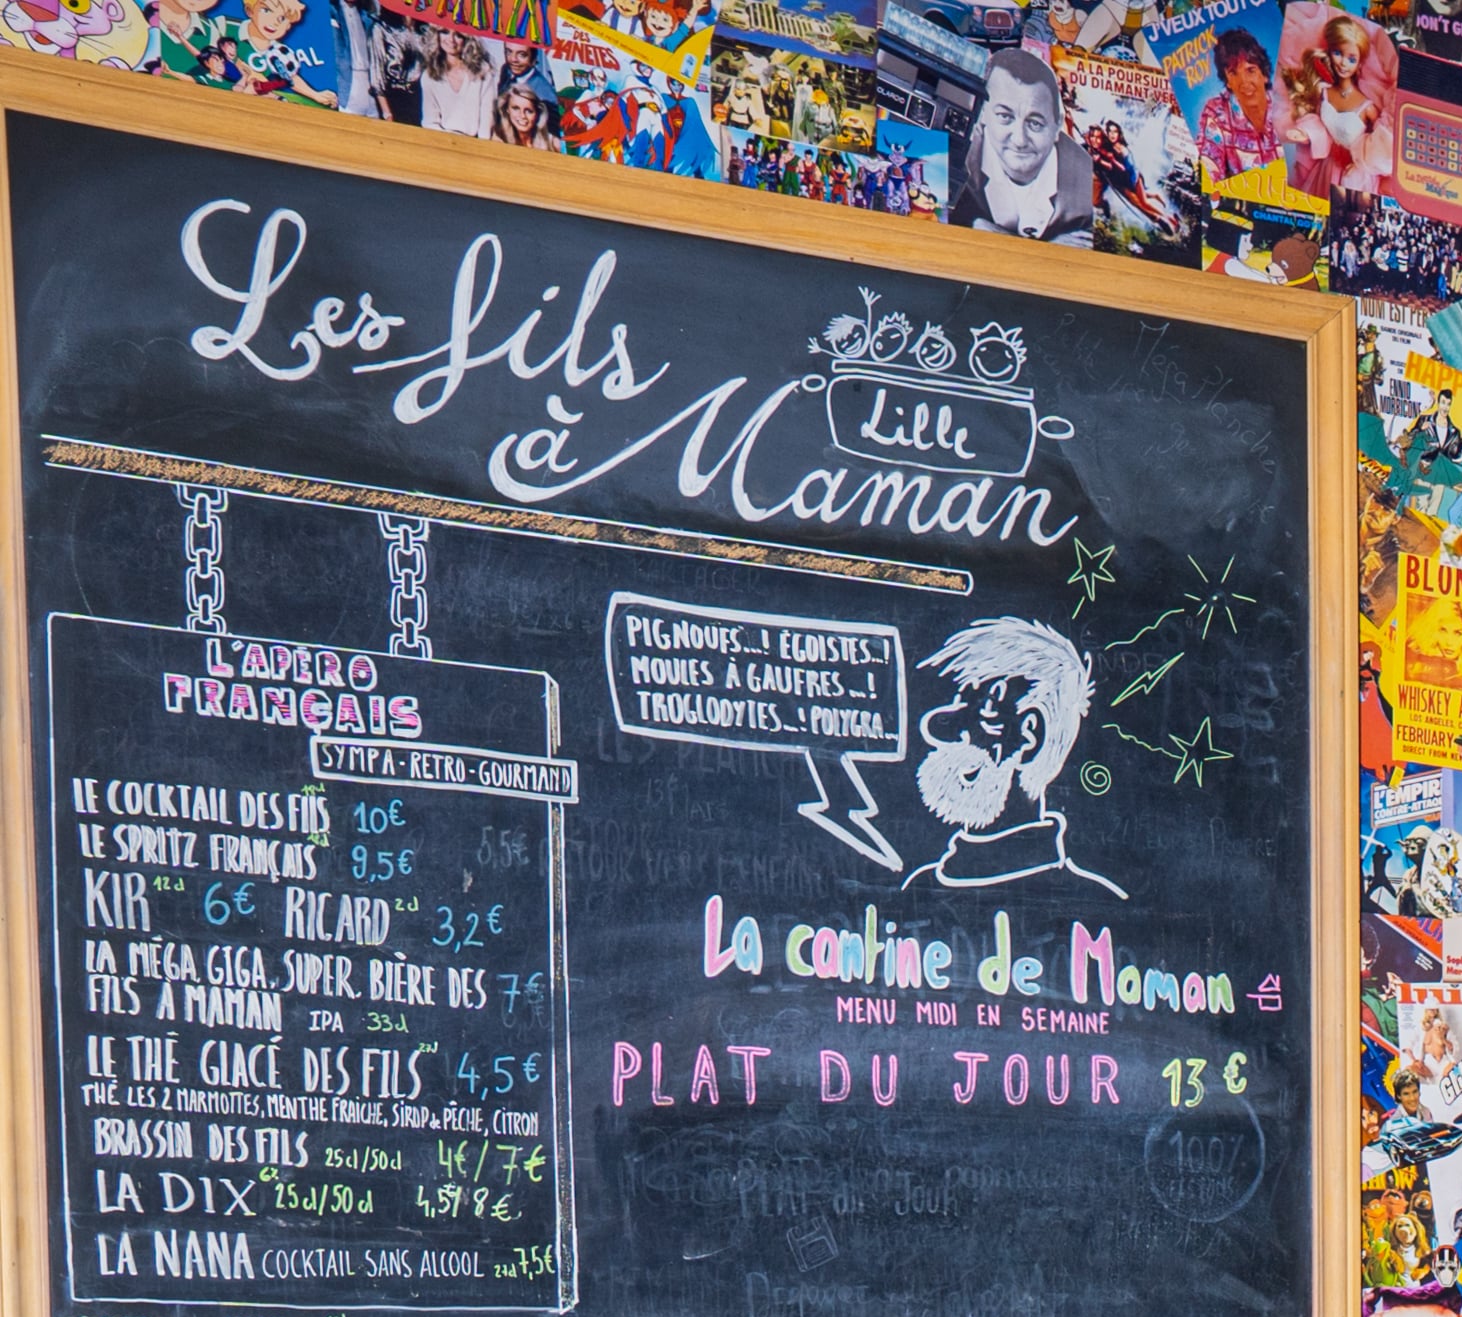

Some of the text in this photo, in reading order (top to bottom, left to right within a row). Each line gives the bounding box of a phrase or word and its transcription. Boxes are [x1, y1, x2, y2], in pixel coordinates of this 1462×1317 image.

[1163, 24, 1219, 78] PATRICK
[1186, 57, 1212, 89] ROY
[1070, 71, 1151, 100] DU DIAMANT
[180, 197, 670, 424] Les fils
[861, 402, 976, 459] Lille
[488, 376, 1078, 547] à Maman
[630, 655, 714, 687] MOULES
[164, 672, 422, 740] FRANÇAIS
[1398, 684, 1451, 716] WHISKEY
[1396, 725, 1454, 748] FEBRUARY
[72, 778, 98, 813] LE
[107, 780, 233, 825] COCKTAIL
[240, 790, 285, 830] DES
[79, 823, 107, 859] LE
[112, 824, 198, 868] SPRITZ
[209, 833, 317, 884] FRANÇAIS
[84, 868, 151, 932] KIR
[284, 885, 390, 945] RICARD
[85, 940, 117, 974] LA
[370, 951, 436, 1006] BIÈRE
[448, 966, 487, 1010] DES
[704, 894, 1235, 1015] La cantine de Maman
[87, 973, 345, 1033] FILS À MAMAN IPA
[836, 996, 1110, 1036] MENU MIDI EN SEMAINE
[87, 1030, 423, 1100] LE THÉ GLACÉ DES FILS
[612, 1041, 1121, 1107] PLAT DU JOUR
[81, 1079, 328, 1122] THÉ LES 2 MENTHE
[94, 1117, 309, 1167] BRASSIN DES FILS
[96, 1169, 257, 1216] LA DIX
[97, 1229, 485, 1280] LA NANA COCKTAIL SANS ALCOOL
